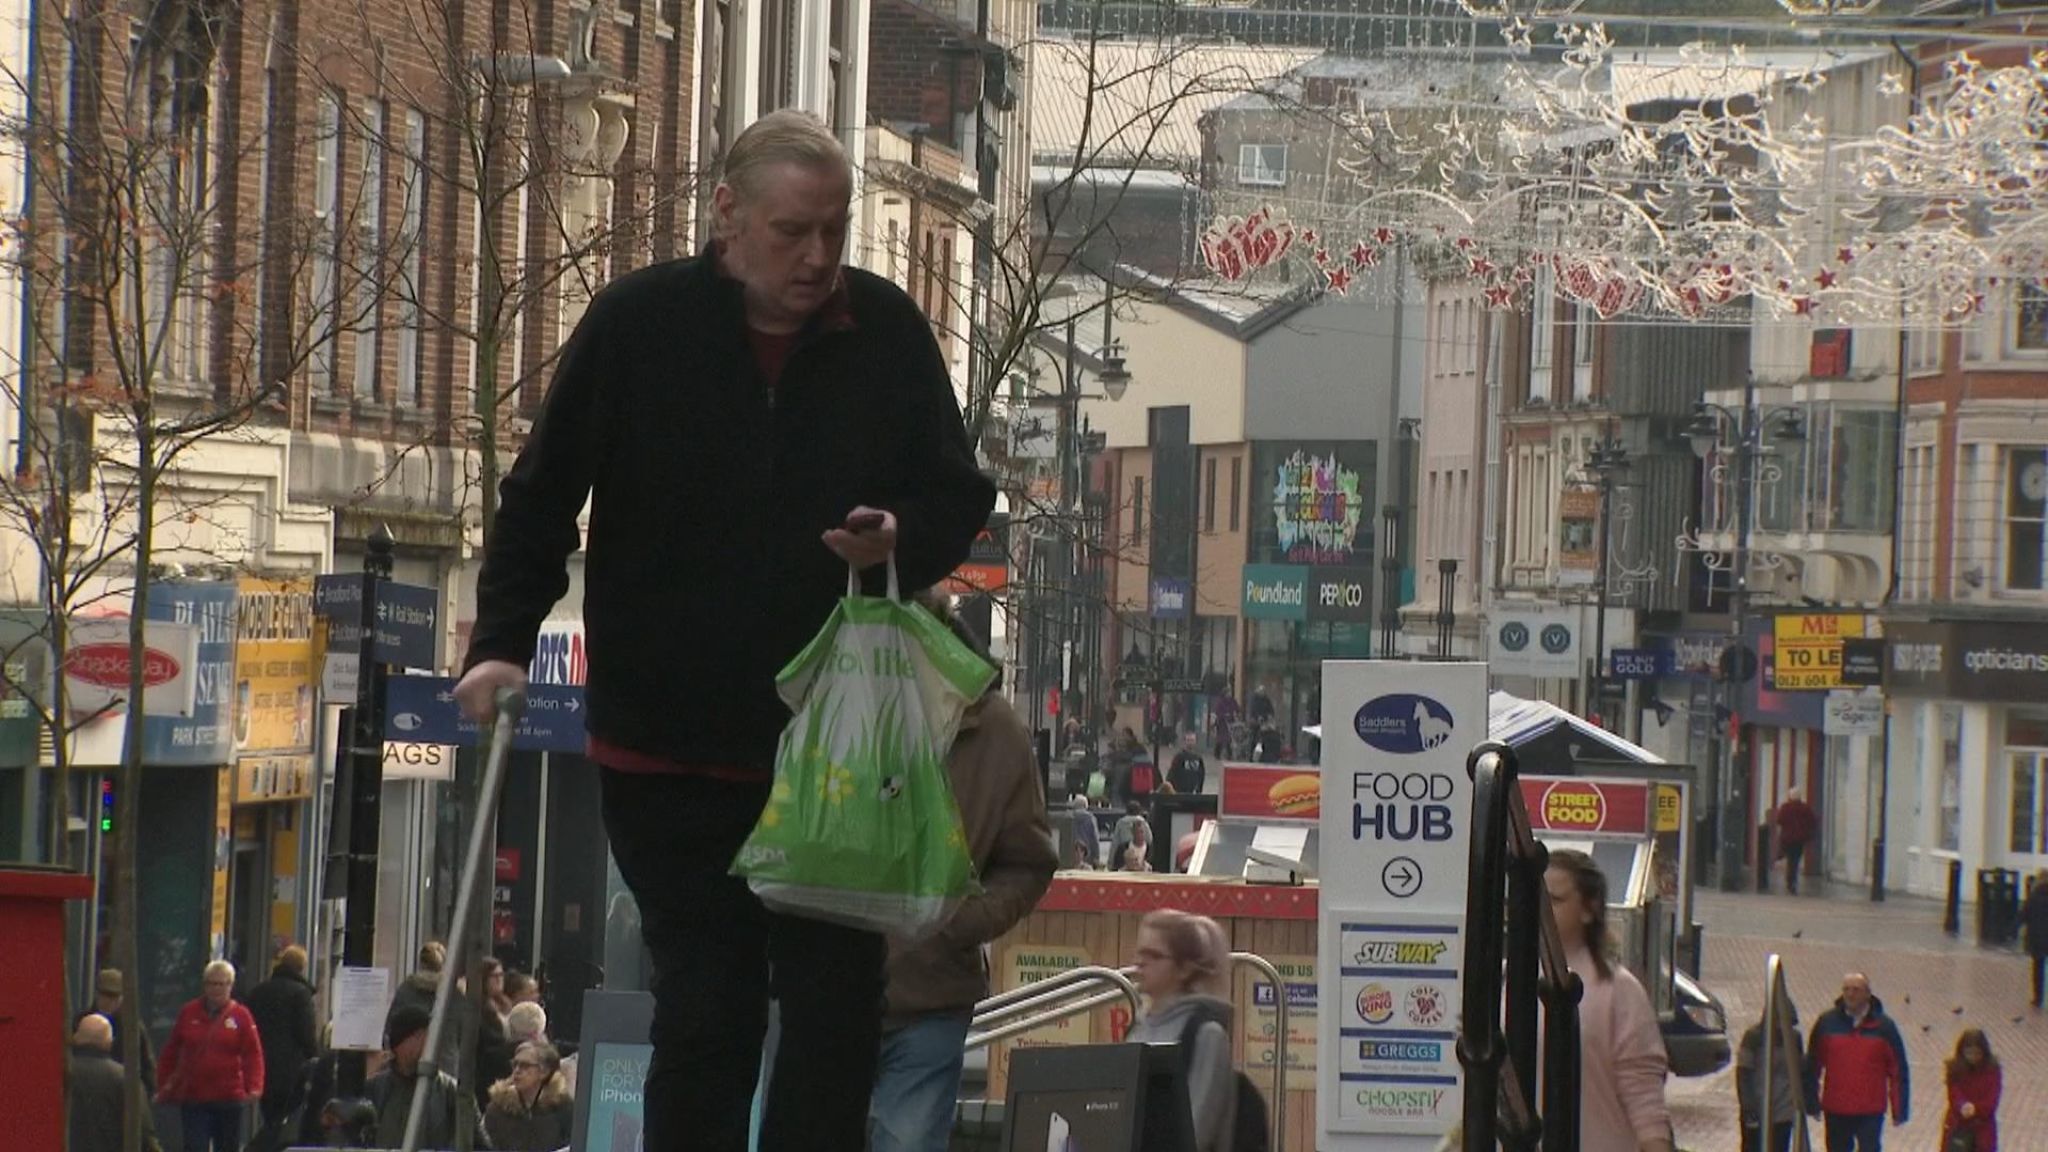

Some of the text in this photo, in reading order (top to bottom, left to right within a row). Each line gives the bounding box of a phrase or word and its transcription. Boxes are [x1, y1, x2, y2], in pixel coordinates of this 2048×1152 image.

[1246, 579, 1302, 605] Poundland
[238, 594, 278, 639] MOBILE
[1616, 655, 1632, 664] WE
[1787, 649, 1841, 667] TO LE
[1965, 647, 2048, 674] opticians
[1616, 664, 1654, 674] GOLD
[527, 695, 559, 709] ation
[173, 727, 193, 745] PARK
[383, 742, 441, 766] AGS
[1352, 772, 1454, 801] FOOD
[1549, 793, 1600, 807] STREET
[1658, 795, 1676, 808] EE
[1352, 803, 1454, 841] HUB
[1549, 807, 1599, 823] FOOD
[1355, 940, 1447, 965] SUBWAY
[1016, 954, 1080, 968] AVAILABLE
[1020, 970, 1043, 983] FOR
[1298, 965, 1313, 977] US
[1361, 1000, 1392, 1017] KING
[1377, 1042, 1437, 1060] GREGGS
[603, 1058, 646, 1074] ONLY
[602, 1073, 634, 1088] FOR
[600, 1088, 642, 1103] iPhon
